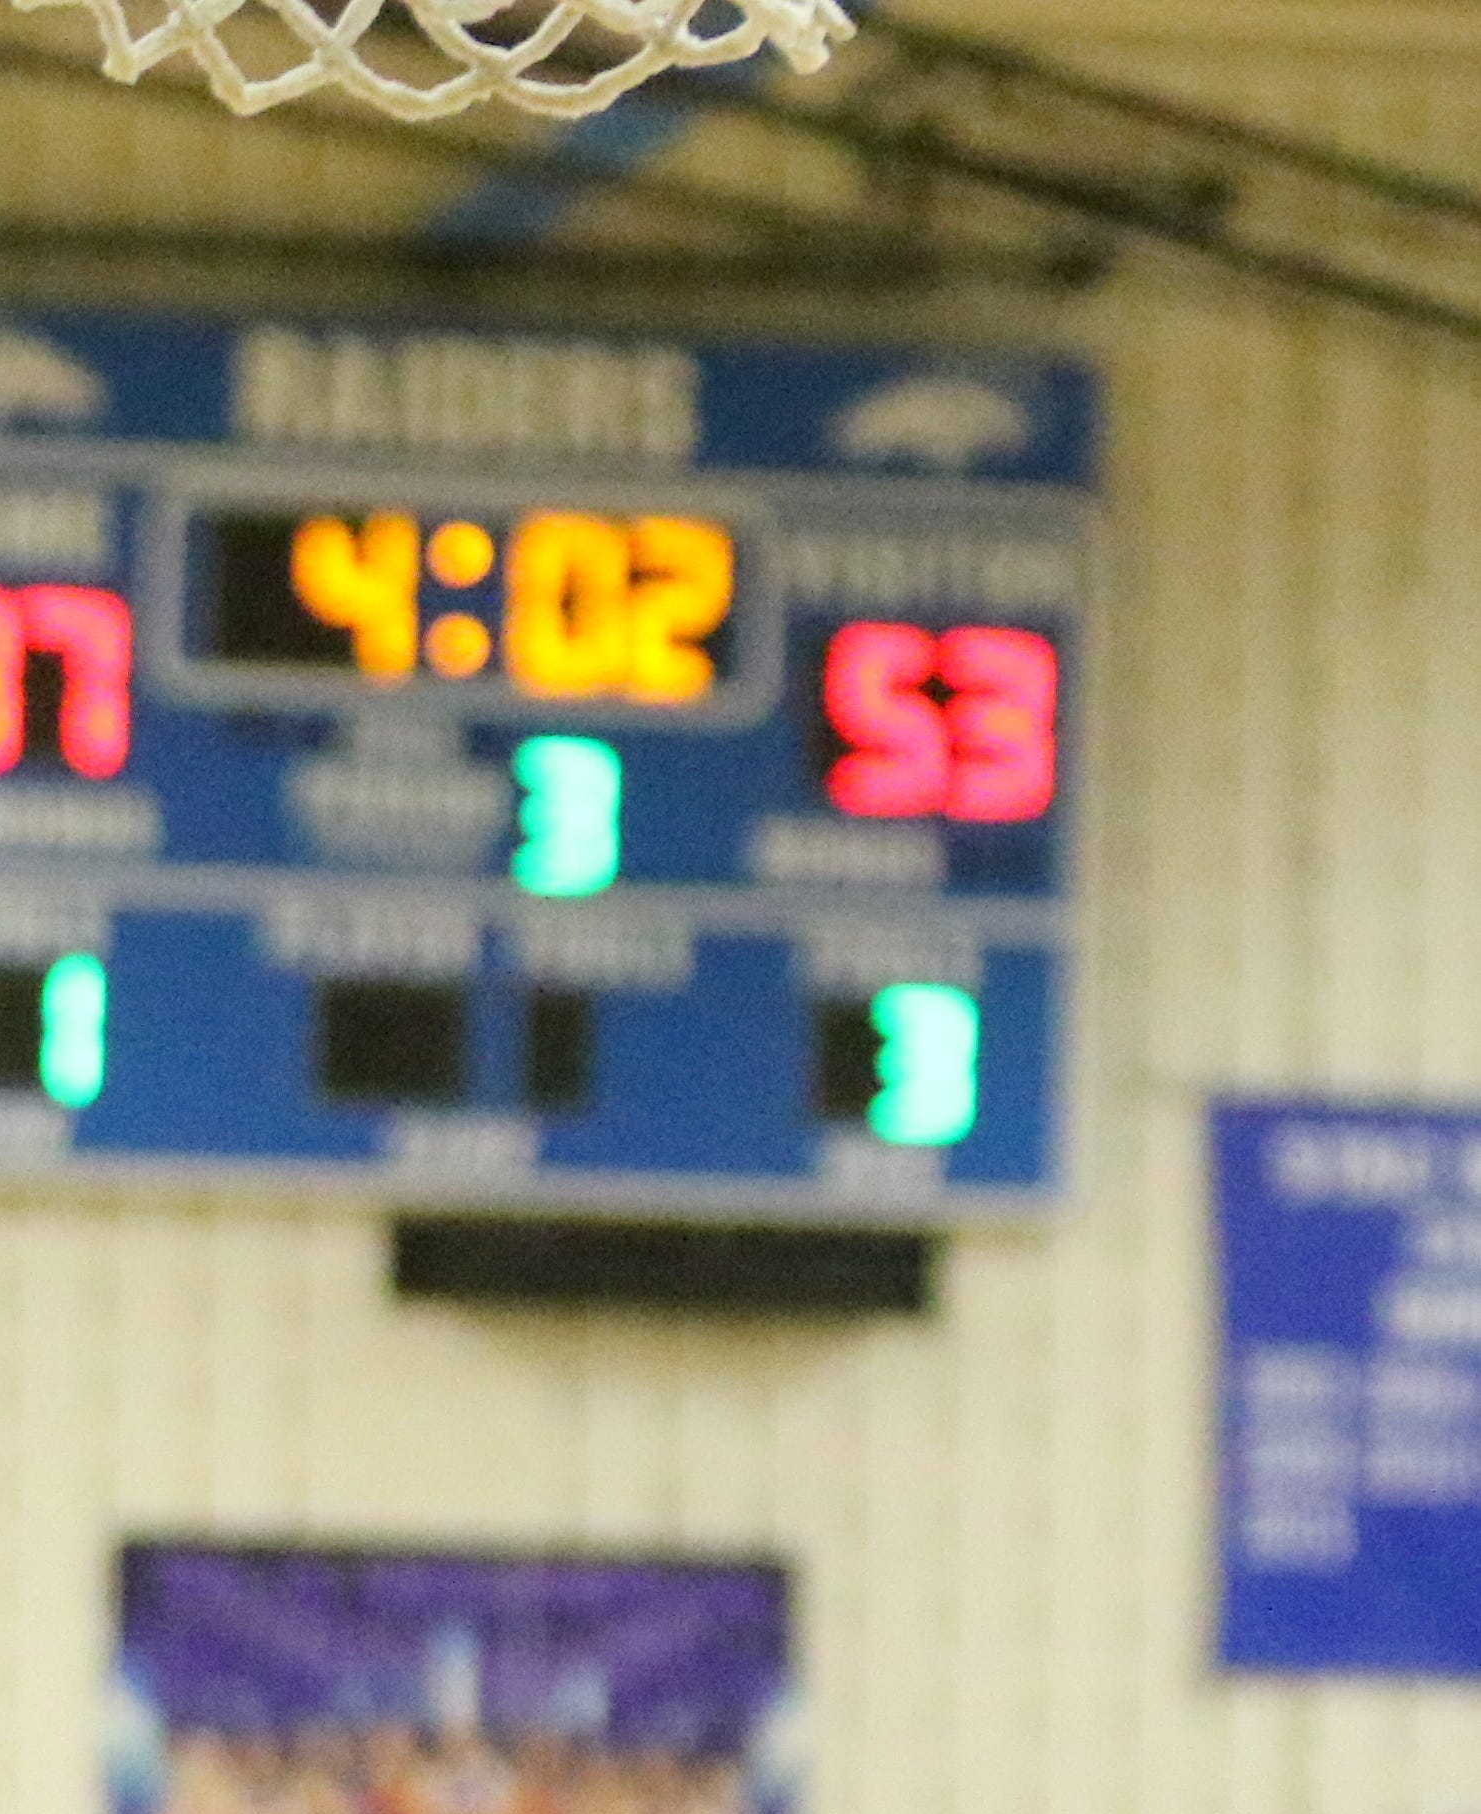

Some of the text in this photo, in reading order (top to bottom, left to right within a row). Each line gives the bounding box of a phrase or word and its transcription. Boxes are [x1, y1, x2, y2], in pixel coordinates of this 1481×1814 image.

[292, 508, 734, 706] 4:02
[822, 622, 1058, 823] 53
[511, 734, 623, 898] 3
[39, 952, 107, 1110] 1
[868, 983, 979, 1147] 3
